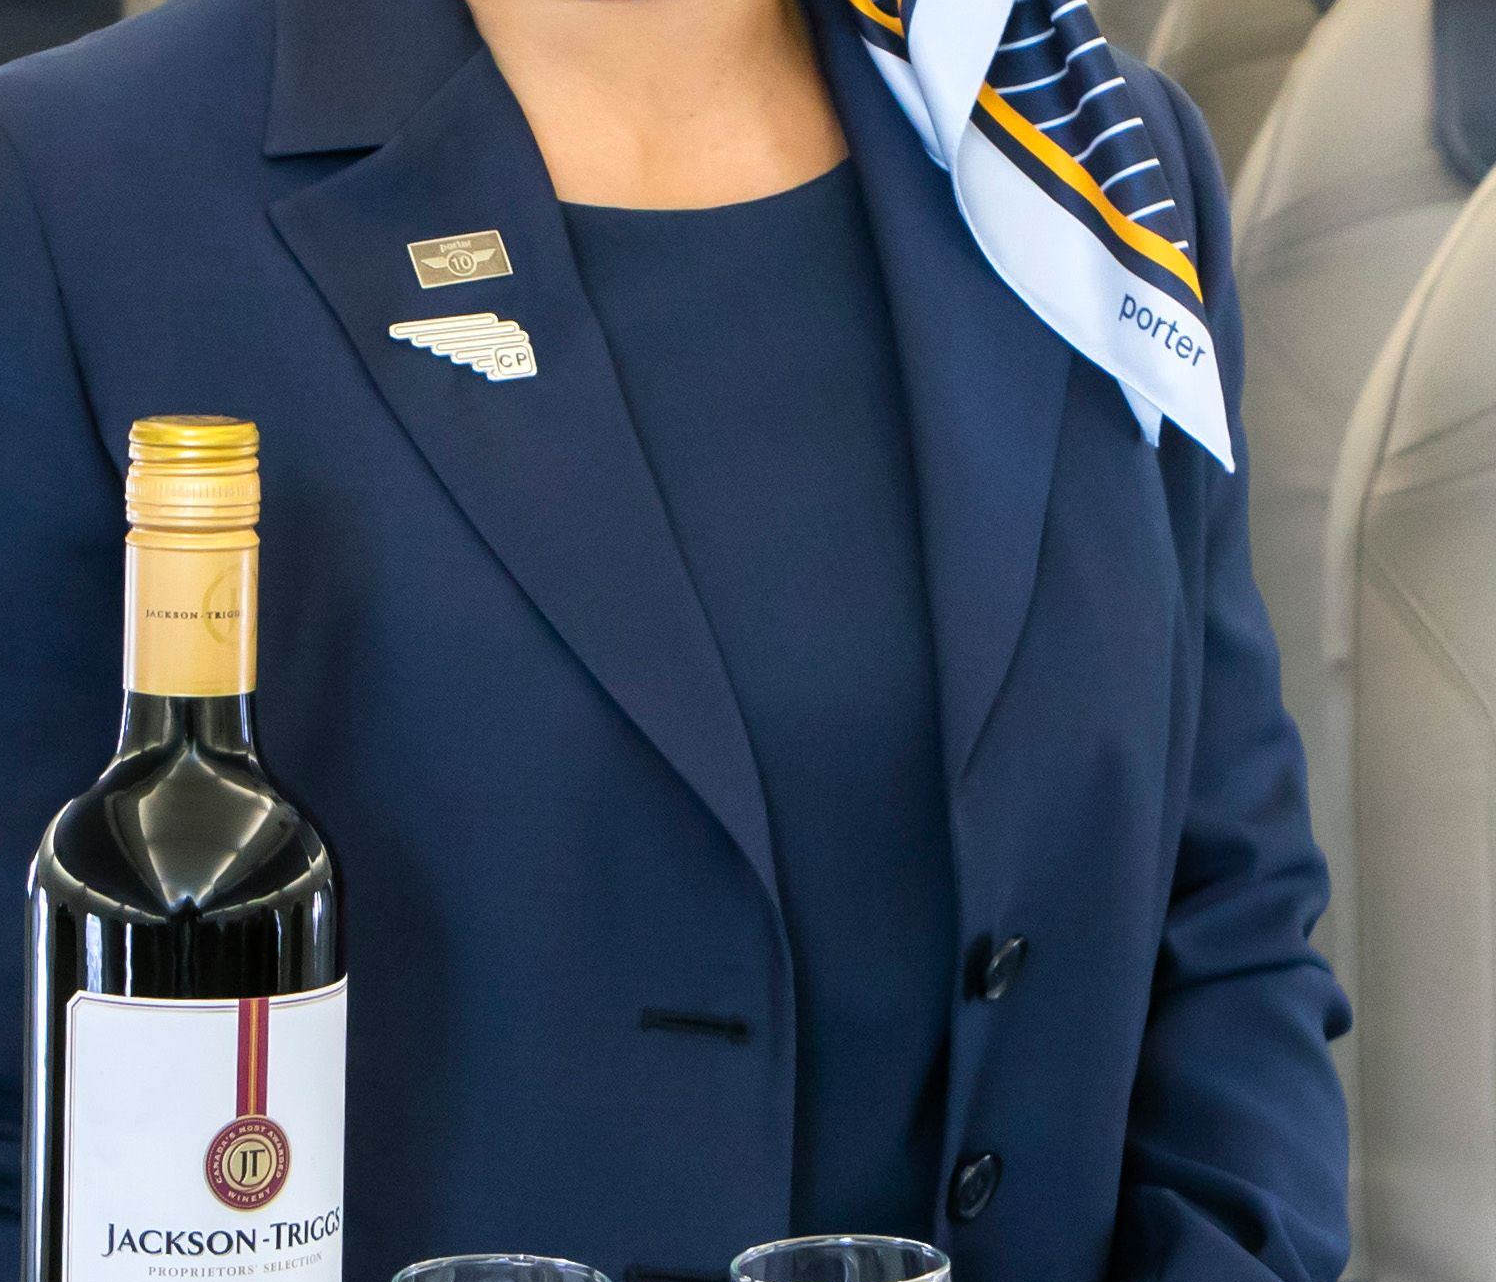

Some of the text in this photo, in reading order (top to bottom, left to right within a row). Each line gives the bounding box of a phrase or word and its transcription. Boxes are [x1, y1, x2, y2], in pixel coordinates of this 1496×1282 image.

[451, 256, 473, 271] 10
[1118, 293, 1207, 367] porter
[238, 1149, 266, 1185] JT
[228, 1187, 271, 1203] WINERY
[148, 1251, 323, 1278] PROPRIETORS' SELECTION
